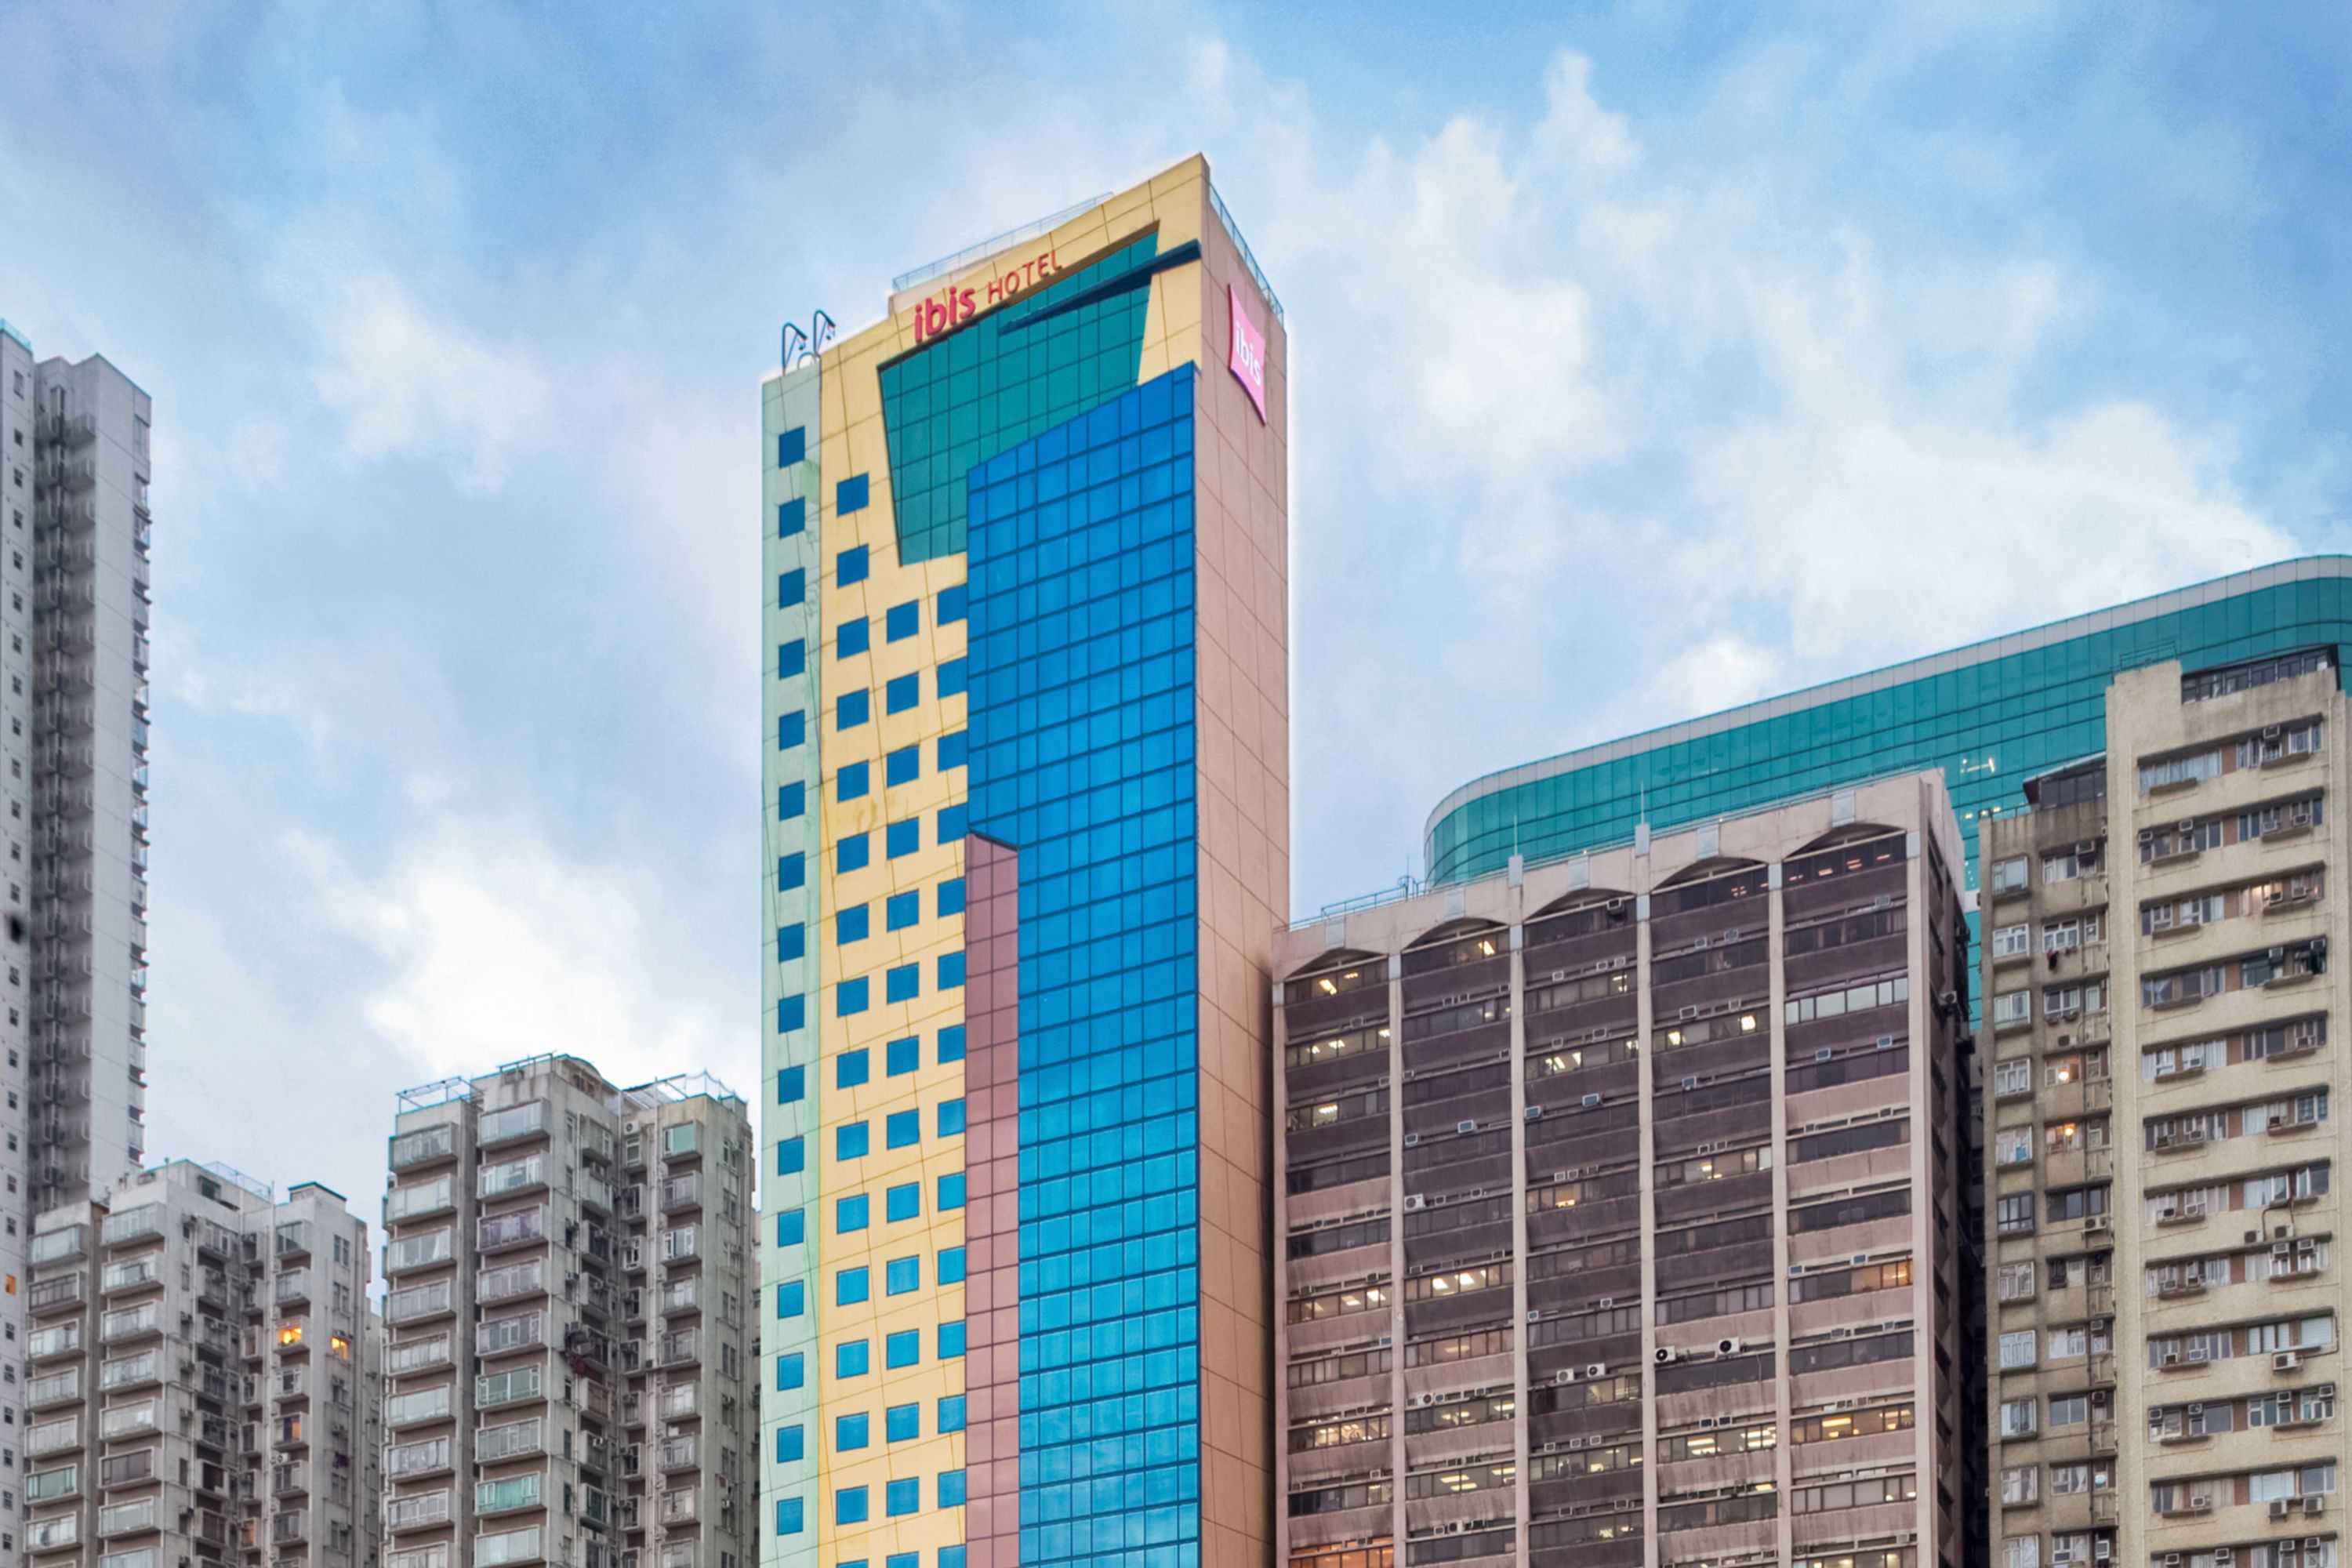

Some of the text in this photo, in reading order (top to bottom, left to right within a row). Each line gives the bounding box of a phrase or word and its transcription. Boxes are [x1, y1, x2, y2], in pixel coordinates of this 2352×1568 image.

[914, 249, 1062, 343] ibis HOTEL
[1236, 320, 1261, 387] ibis
